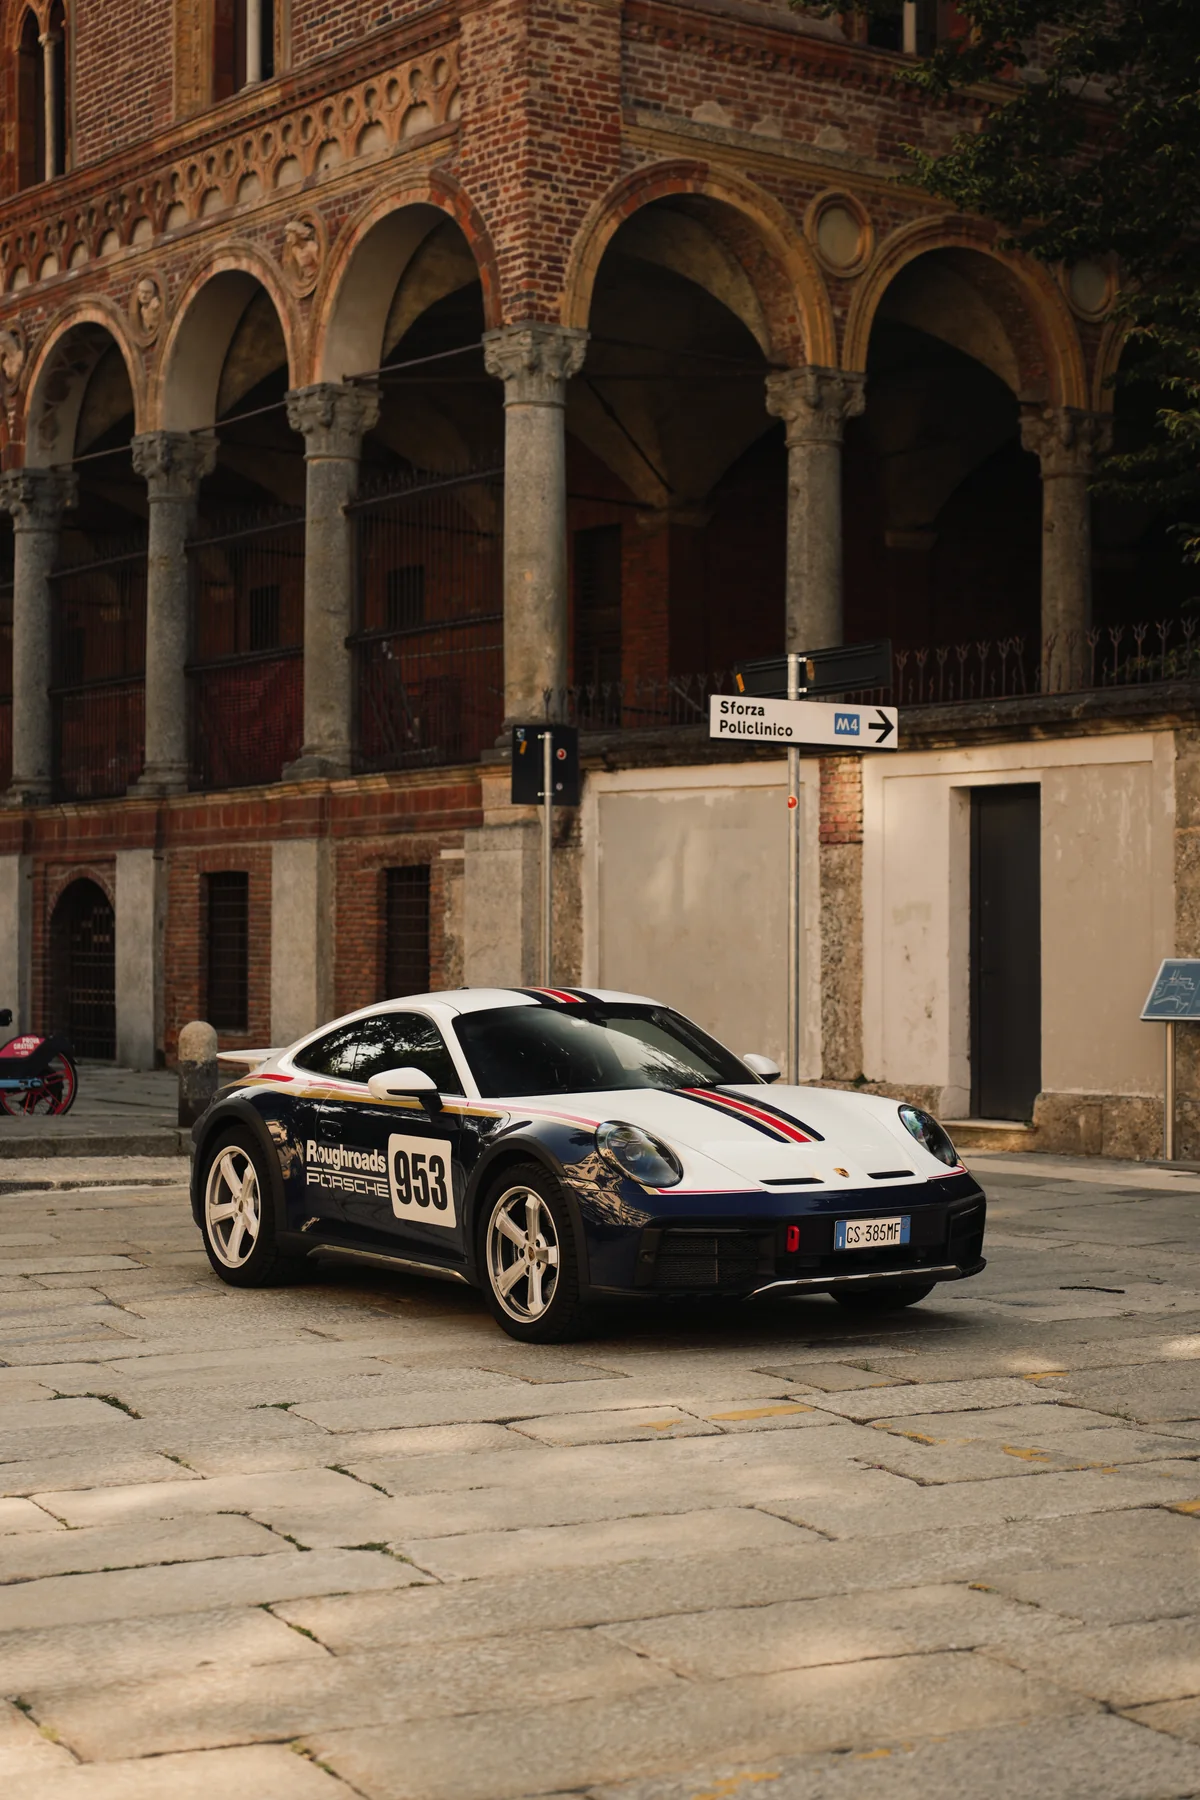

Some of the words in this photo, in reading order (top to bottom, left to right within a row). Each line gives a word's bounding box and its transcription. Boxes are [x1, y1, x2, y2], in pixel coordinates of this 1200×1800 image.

[720, 701, 765, 716] Sforza
[719, 720, 793, 737] Policlinico
[836, 717, 859, 731] M4
[306, 1139, 387, 1173] Roughroads
[306, 1172, 390, 1198] PORSCHE
[394, 1150, 448, 1211] 953
